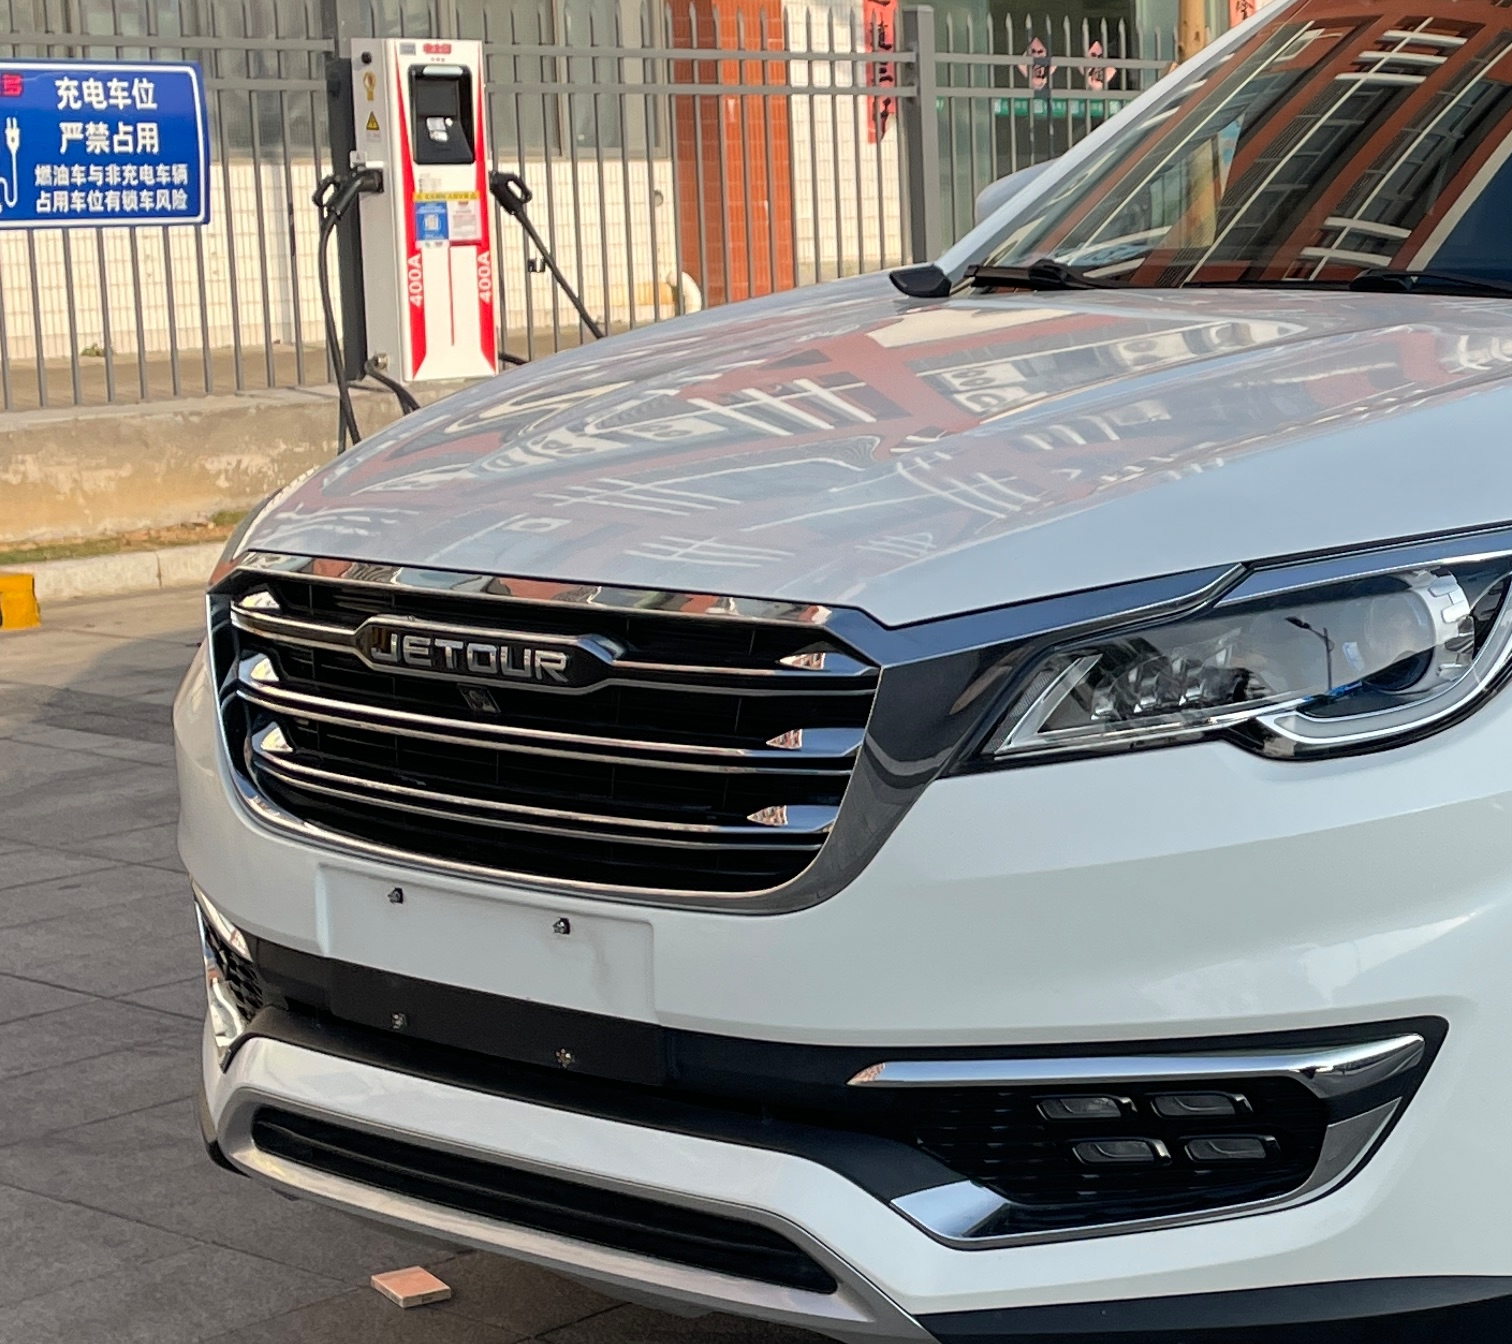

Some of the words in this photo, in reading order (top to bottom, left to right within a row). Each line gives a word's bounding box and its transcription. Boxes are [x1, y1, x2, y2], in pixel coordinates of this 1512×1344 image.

[55, 76, 158, 110] 充电车位
[59, 121, 159, 155] 严禁占用
[34, 163, 189, 186] 燃油车与非充电车辆
[36, 189, 188, 213] 占用车位有锁车风险
[408, 253, 422, 307] 400A
[477, 251, 491, 304] 400A
[370, 632, 569, 683] JETOUR
